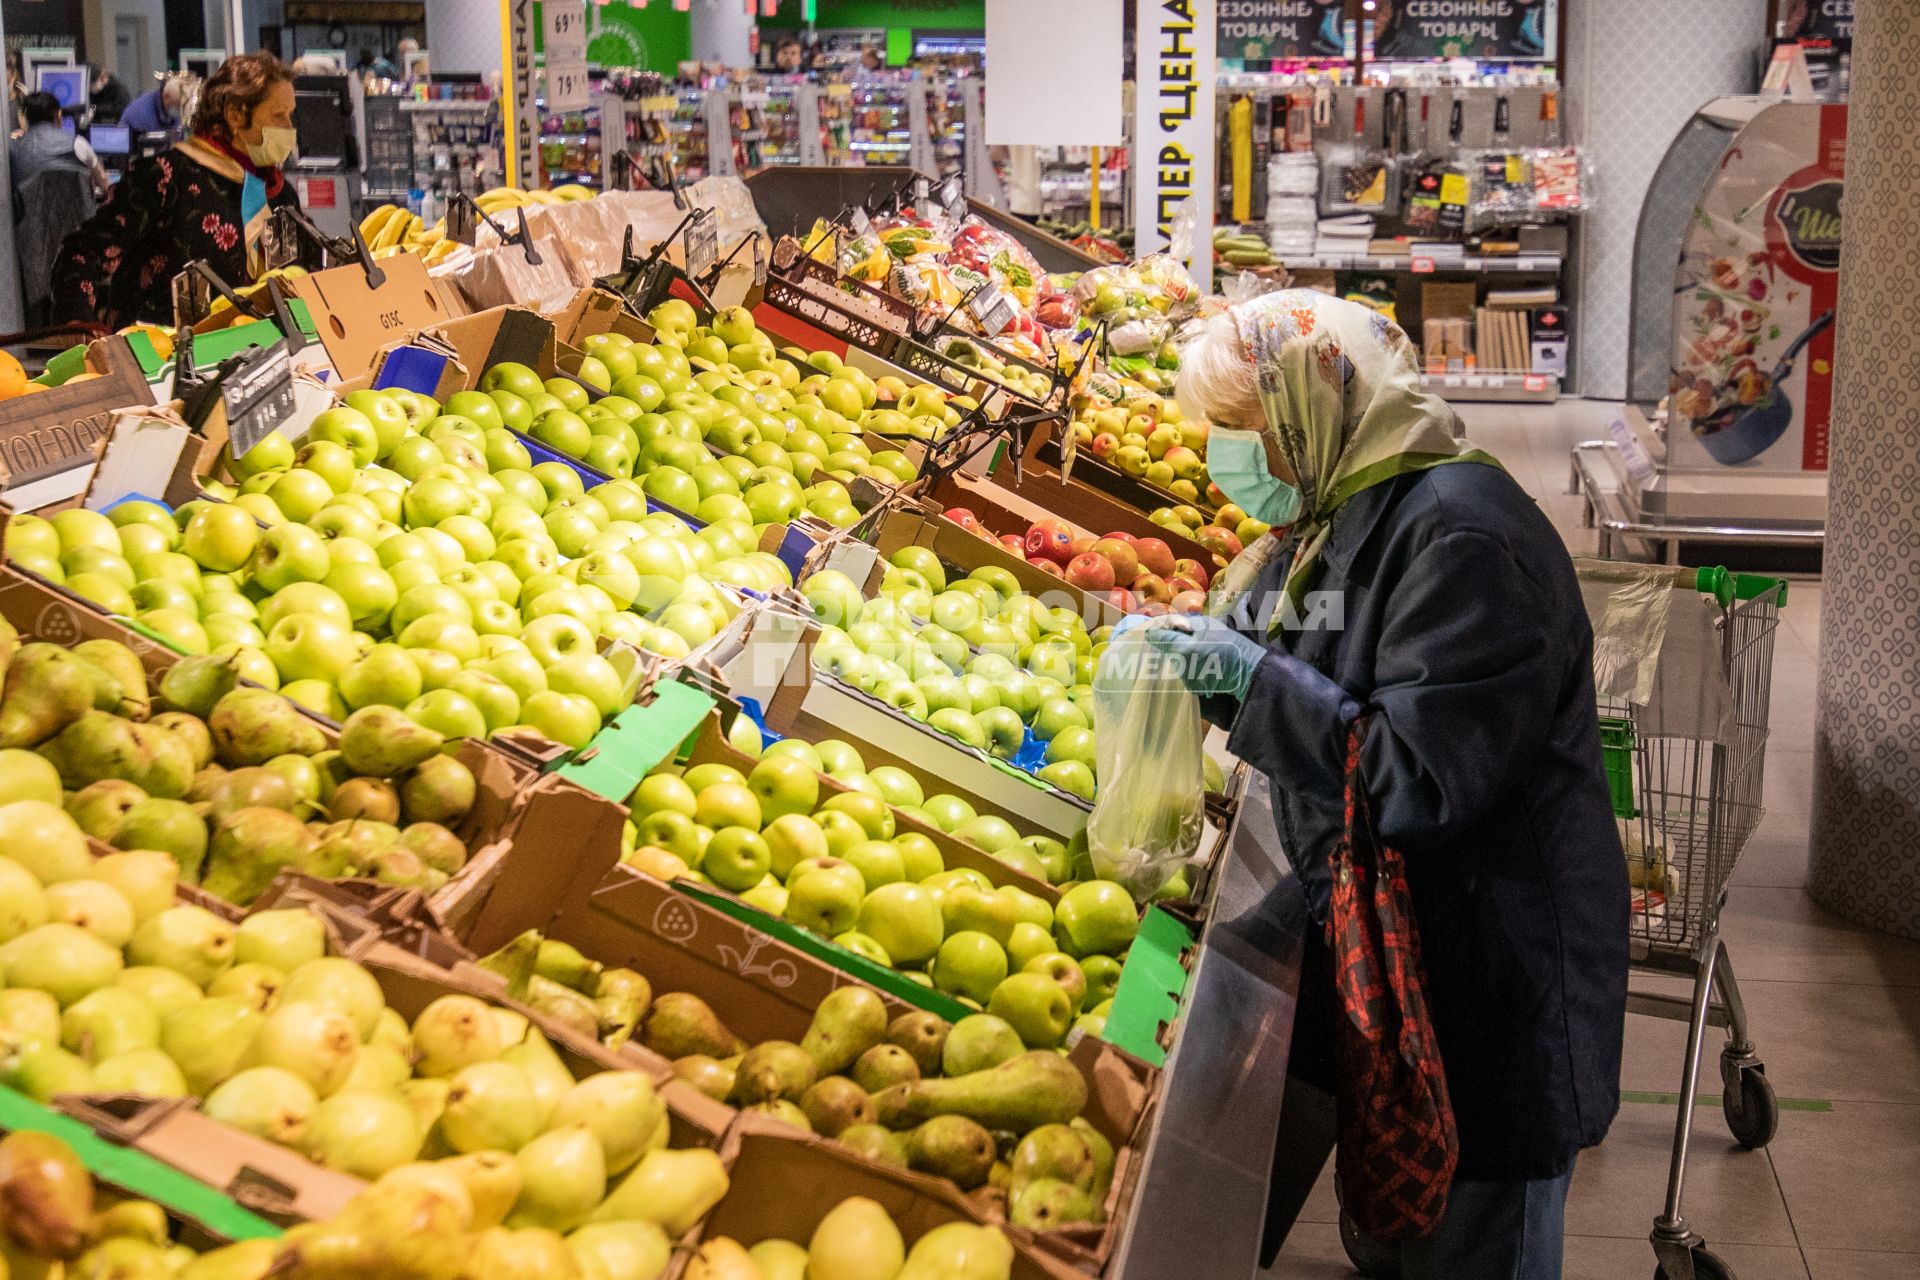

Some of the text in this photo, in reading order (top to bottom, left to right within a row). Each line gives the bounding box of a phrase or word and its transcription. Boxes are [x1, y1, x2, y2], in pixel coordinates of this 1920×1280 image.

[1217, 0, 1313, 17] ЕЗОННЫЕ
[1406, 0, 1514, 17] СЕЗОННЫЕ
[1220, 21, 1299, 41] ТОВАРЫ
[1419, 21, 1499, 41] ТОВАРЫ
[1159, 0, 1200, 133] ЦЕНА
[380, 310, 403, 329] G15C
